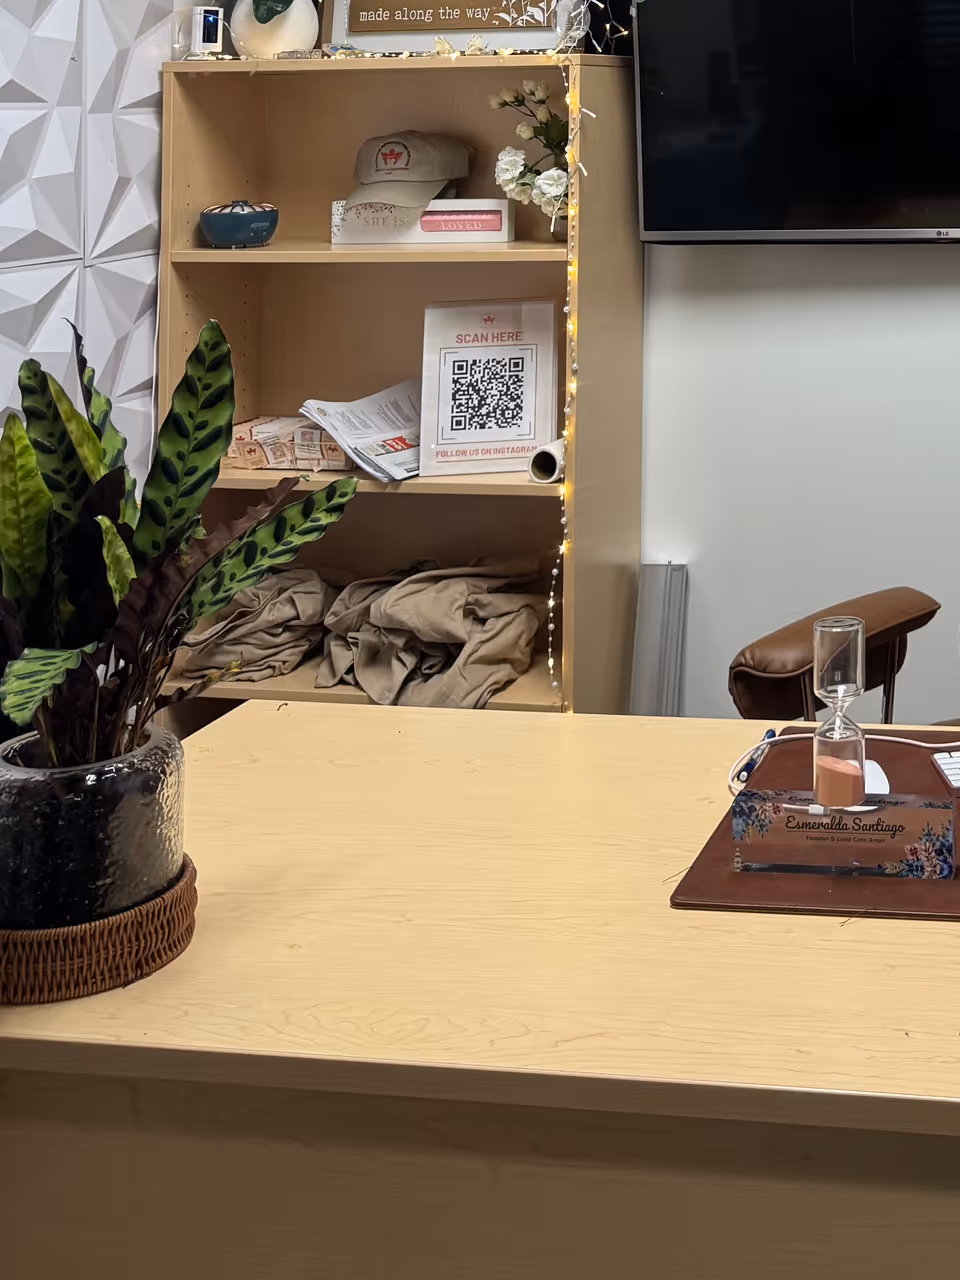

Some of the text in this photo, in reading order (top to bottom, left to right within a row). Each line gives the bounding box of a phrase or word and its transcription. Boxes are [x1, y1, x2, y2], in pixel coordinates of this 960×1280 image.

[359, 6, 491, 22] made along the way
[363, 216, 482, 231] SHE IS LOVED
[455, 331, 523, 344] SCAN HERE
[435, 445, 538, 458] FOLLOW US ON INSTAGRAM
[785, 815, 906, 839] Esmeralda Santiago
